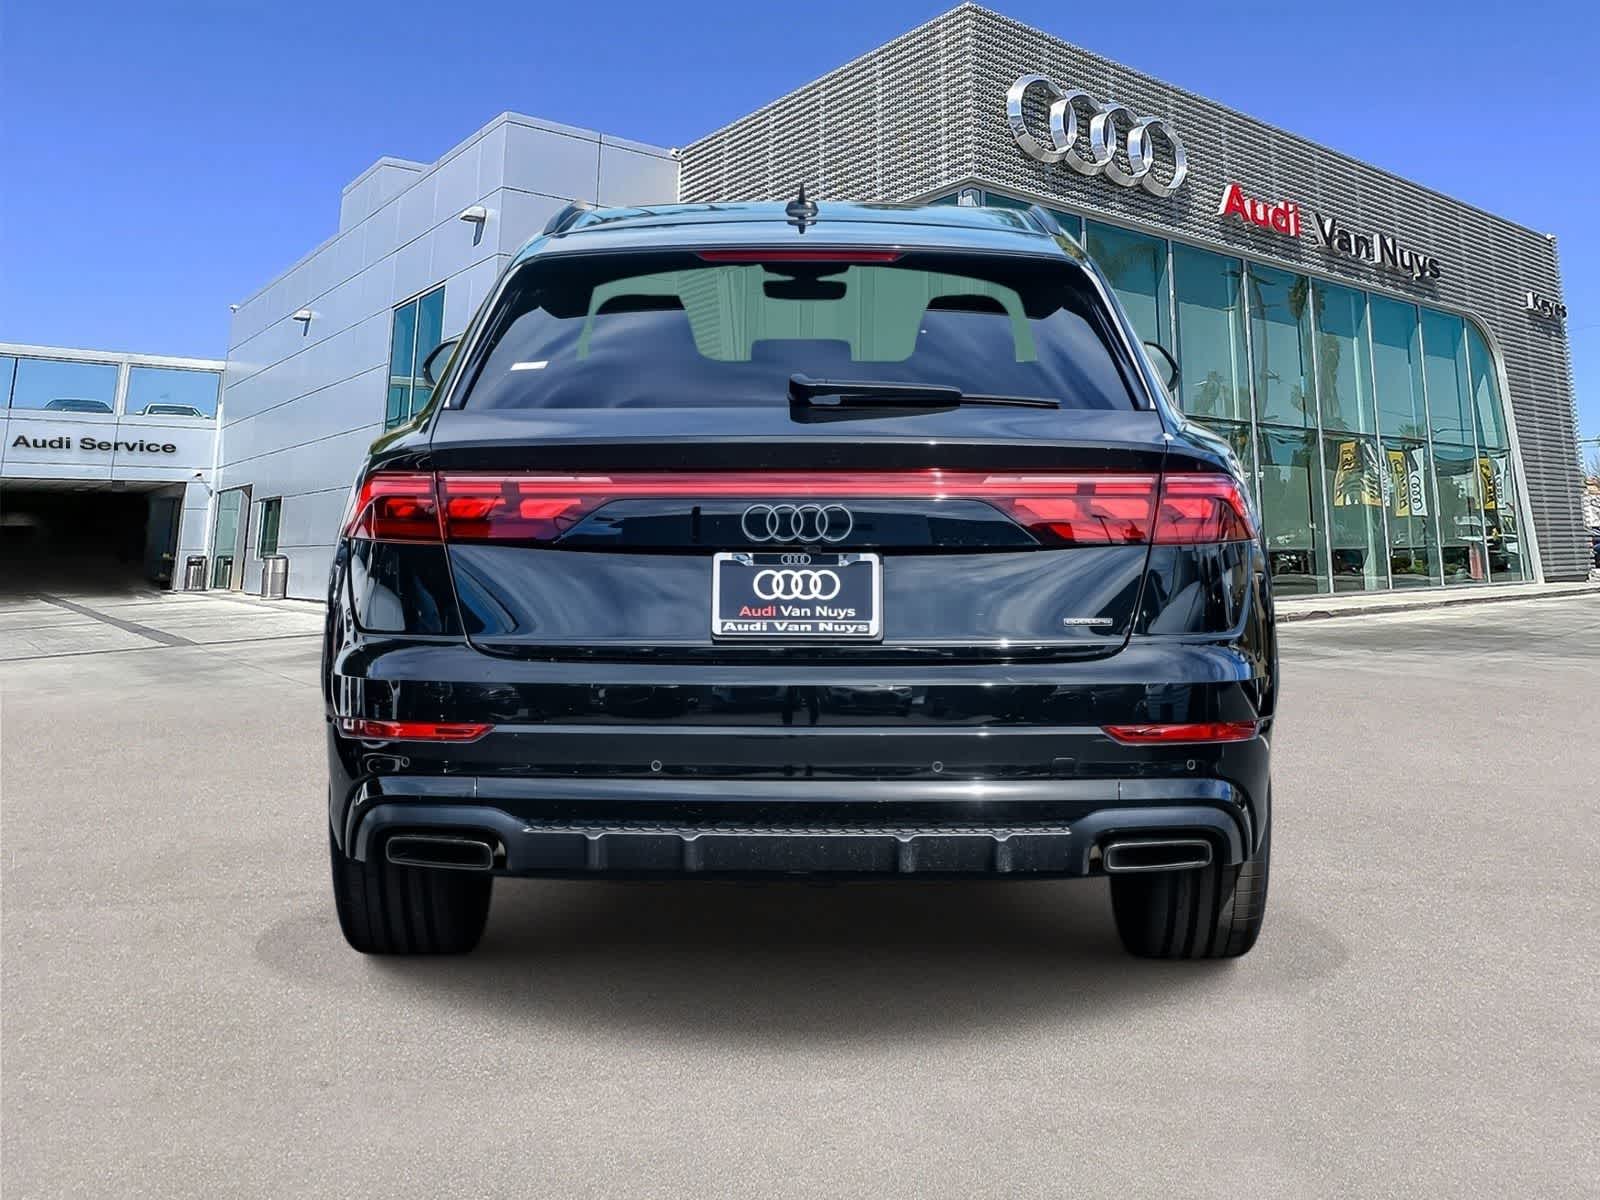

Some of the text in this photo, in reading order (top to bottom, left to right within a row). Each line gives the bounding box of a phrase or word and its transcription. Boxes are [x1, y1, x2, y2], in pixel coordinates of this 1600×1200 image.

[1218, 182, 1441, 280] Audi Van Nuys
[12, 435, 177, 453] Audi Service
[739, 605, 856, 619] Audi Van Nuys
[722, 622, 868, 633] Audi Van Nuys
